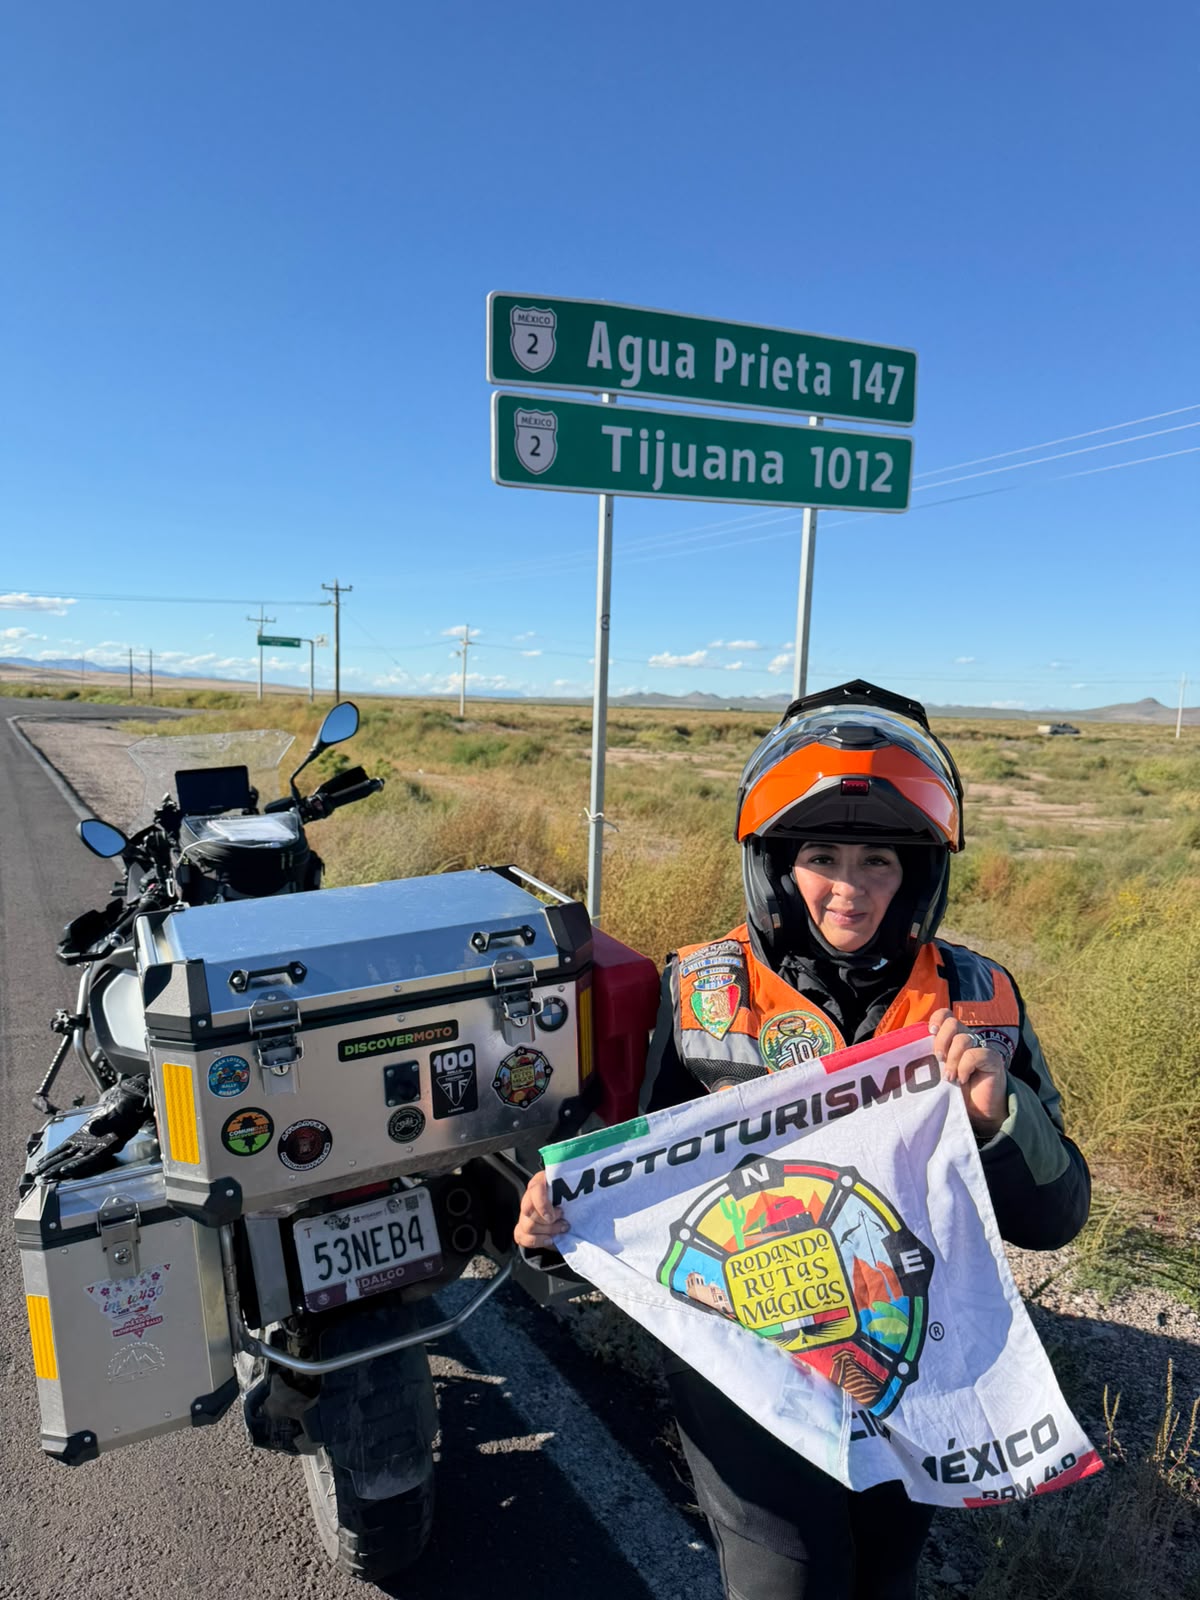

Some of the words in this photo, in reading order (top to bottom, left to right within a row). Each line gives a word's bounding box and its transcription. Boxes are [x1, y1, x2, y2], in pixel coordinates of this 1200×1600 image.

[518, 313, 551, 325] MÉXICO
[527, 333, 539, 355] 2
[587, 321, 696, 388] Agua
[714, 338, 831, 397] Prieta
[850, 359, 905, 406] 147
[521, 416, 553, 428] MÉXICO
[530, 435, 541, 457] 2
[601, 425, 784, 491] Tijuana
[810, 446, 894, 494] 1012
[344, 1026, 453, 1056] DISCOVERMOTO
[432, 1048, 474, 1073] 100
[785, 1041, 815, 1066] 10
[229, 1124, 269, 1137] COMUNIDAD
[552, 1054, 941, 1206] MOTOTURISMO
[741, 1163, 770, 1187] N
[304, 1227, 313, 1239] T
[314, 1215, 425, 1281] 53NEB4
[899, 1249, 926, 1274] E
[357, 1267, 405, 1289] IDALGO
